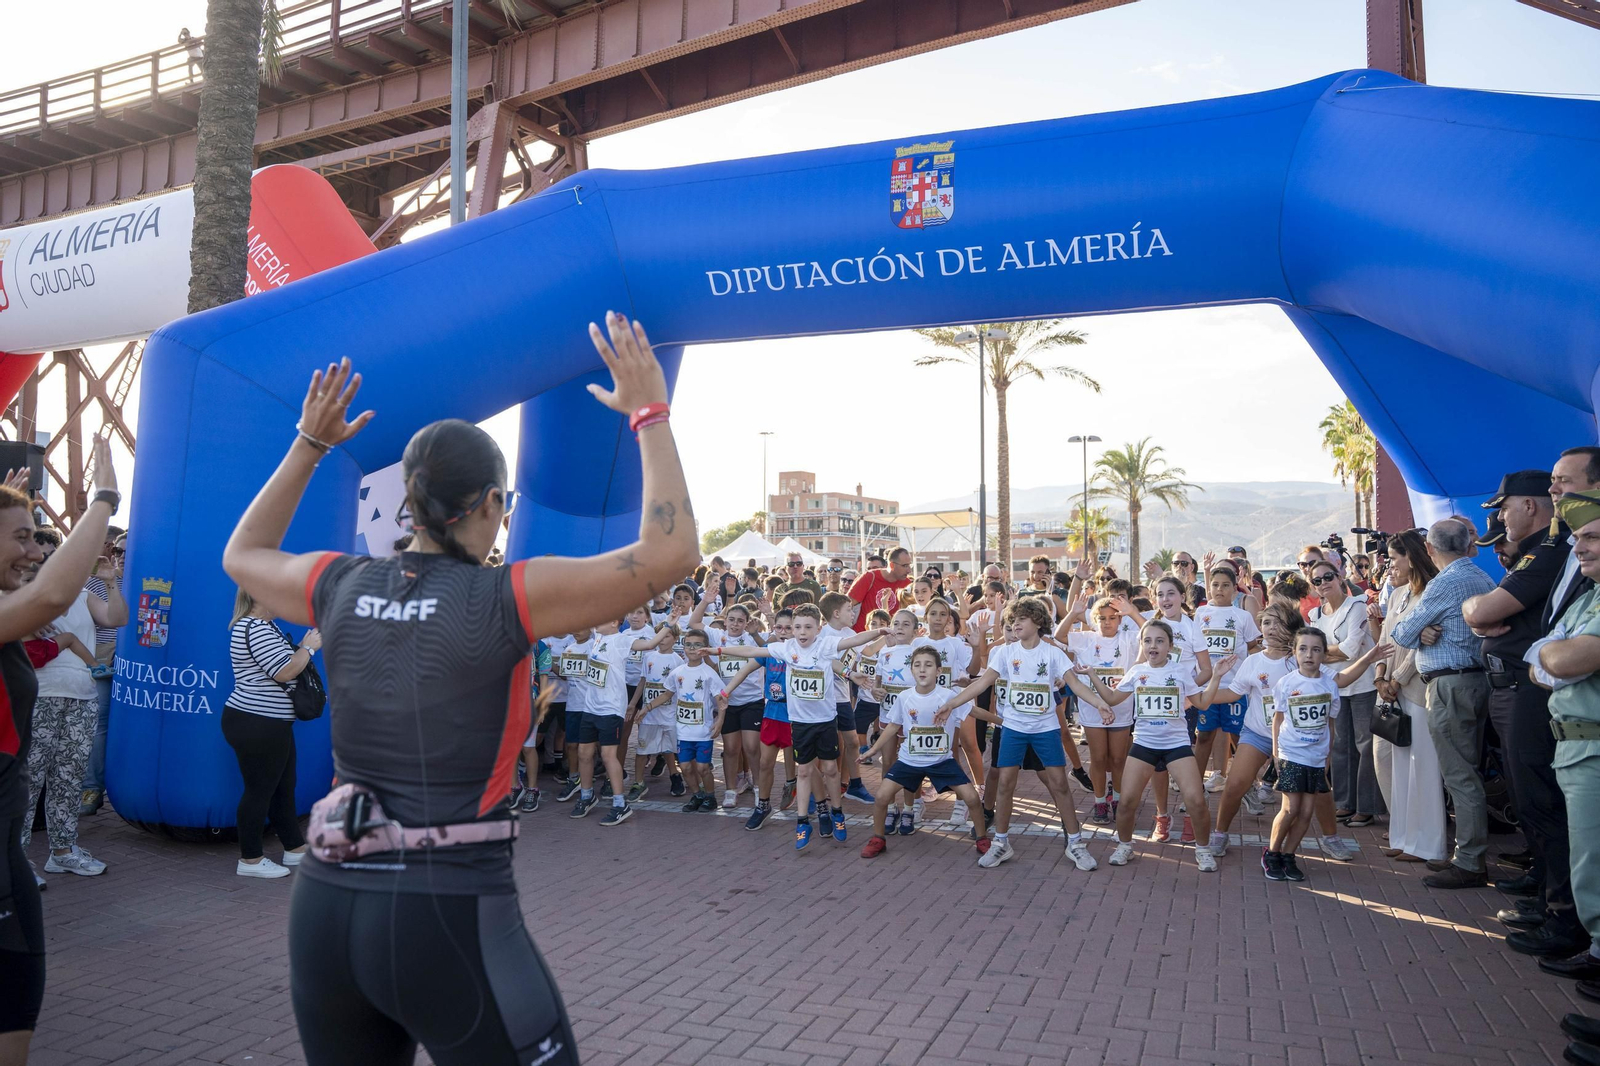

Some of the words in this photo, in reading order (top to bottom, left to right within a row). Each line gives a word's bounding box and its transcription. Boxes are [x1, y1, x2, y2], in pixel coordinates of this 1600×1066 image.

[29, 203, 161, 265] ALMERÍA
[705, 247, 925, 297] DIPUTACIÓN
[936, 245, 987, 277] DE
[997, 221, 1174, 271] ALMERÍA
[30, 263, 96, 298] CIUDAD
[354, 594, 439, 621] STAFF
[1206, 636, 1229, 648] 349
[113, 655, 220, 689] DIPUTACIÓN
[566, 660, 583, 671] 511
[726, 661, 740, 672] 44
[794, 678, 818, 693] 104
[111, 679, 122, 702] DE
[123, 686, 214, 715] ALMERÍA
[1016, 692, 1044, 707] 280
[1144, 696, 1173, 710] 115
[679, 707, 697, 720] 521
[1228, 702, 1242, 716] 10
[1298, 704, 1328, 721] 564
[916, 735, 943, 748] 107
